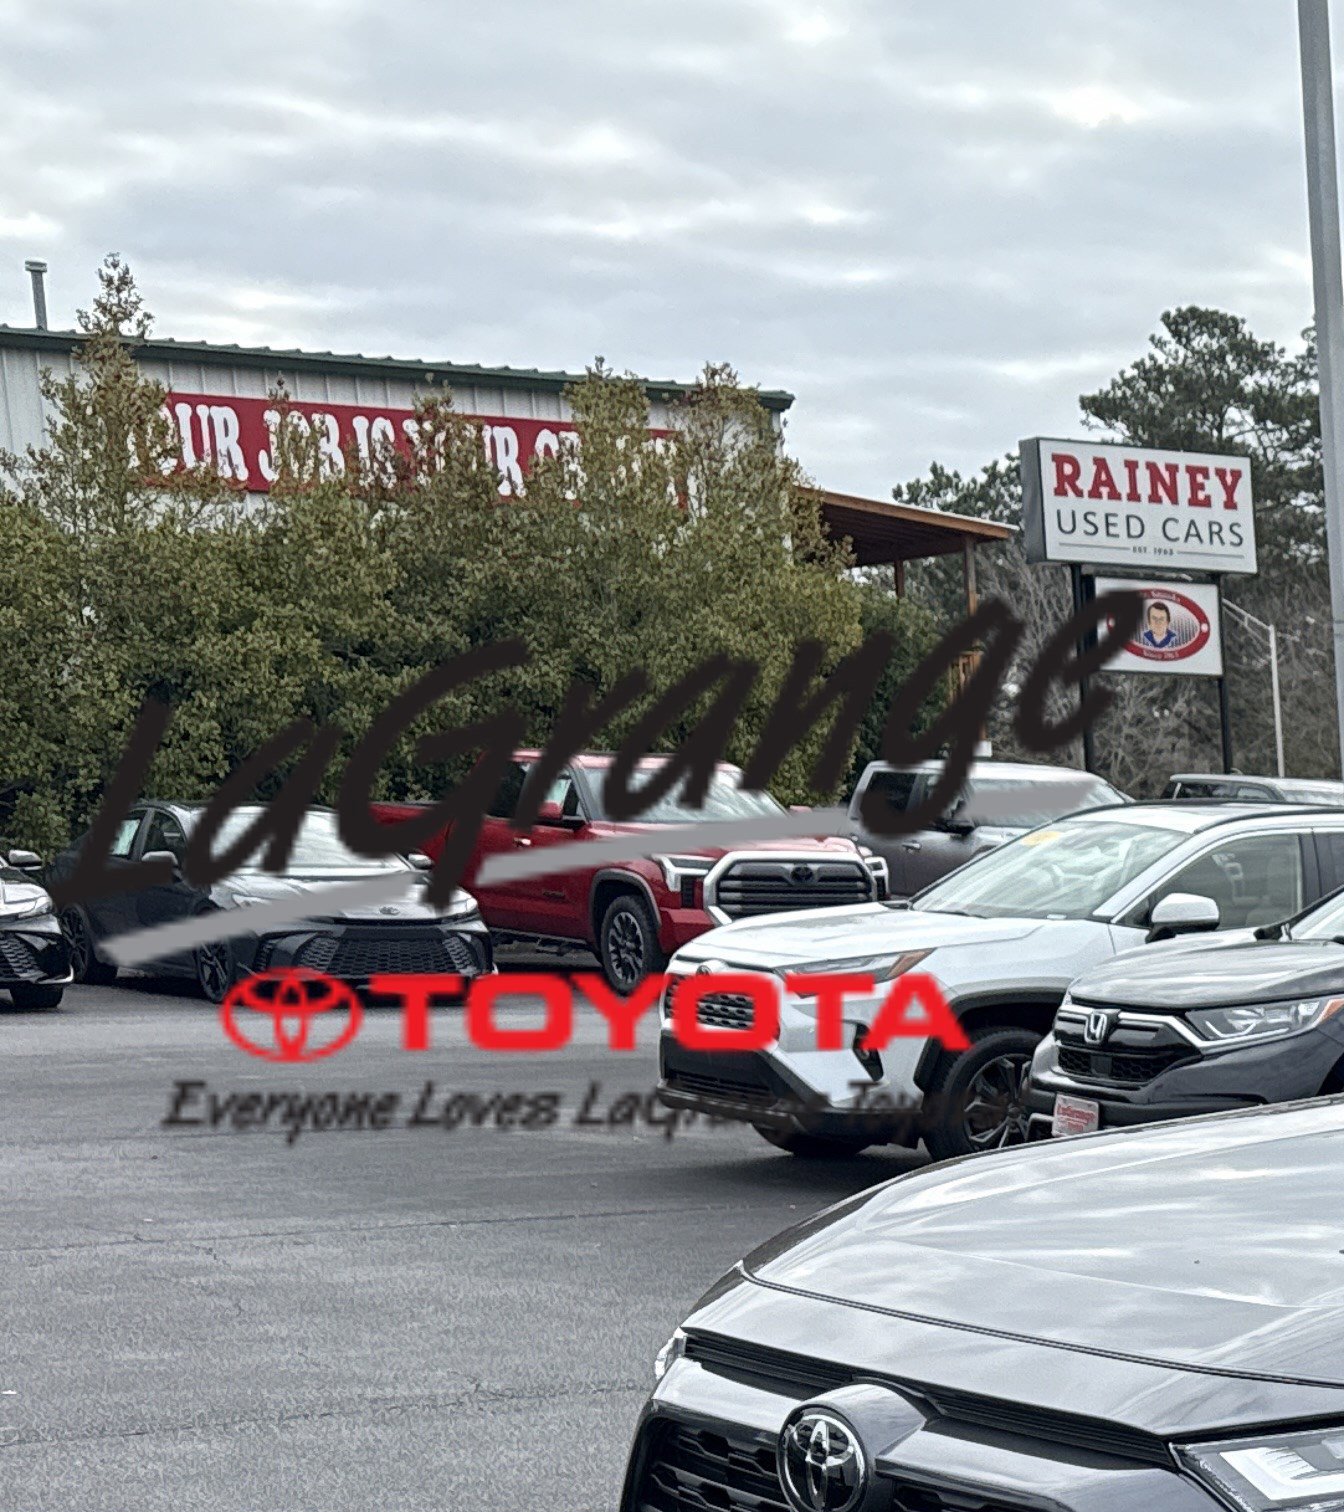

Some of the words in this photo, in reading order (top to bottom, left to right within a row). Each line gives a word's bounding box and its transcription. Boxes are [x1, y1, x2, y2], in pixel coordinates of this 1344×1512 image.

[1051, 452, 1243, 510] RAINEY
[1056, 508, 1146, 540] USED
[1161, 516, 1244, 548] CARS
